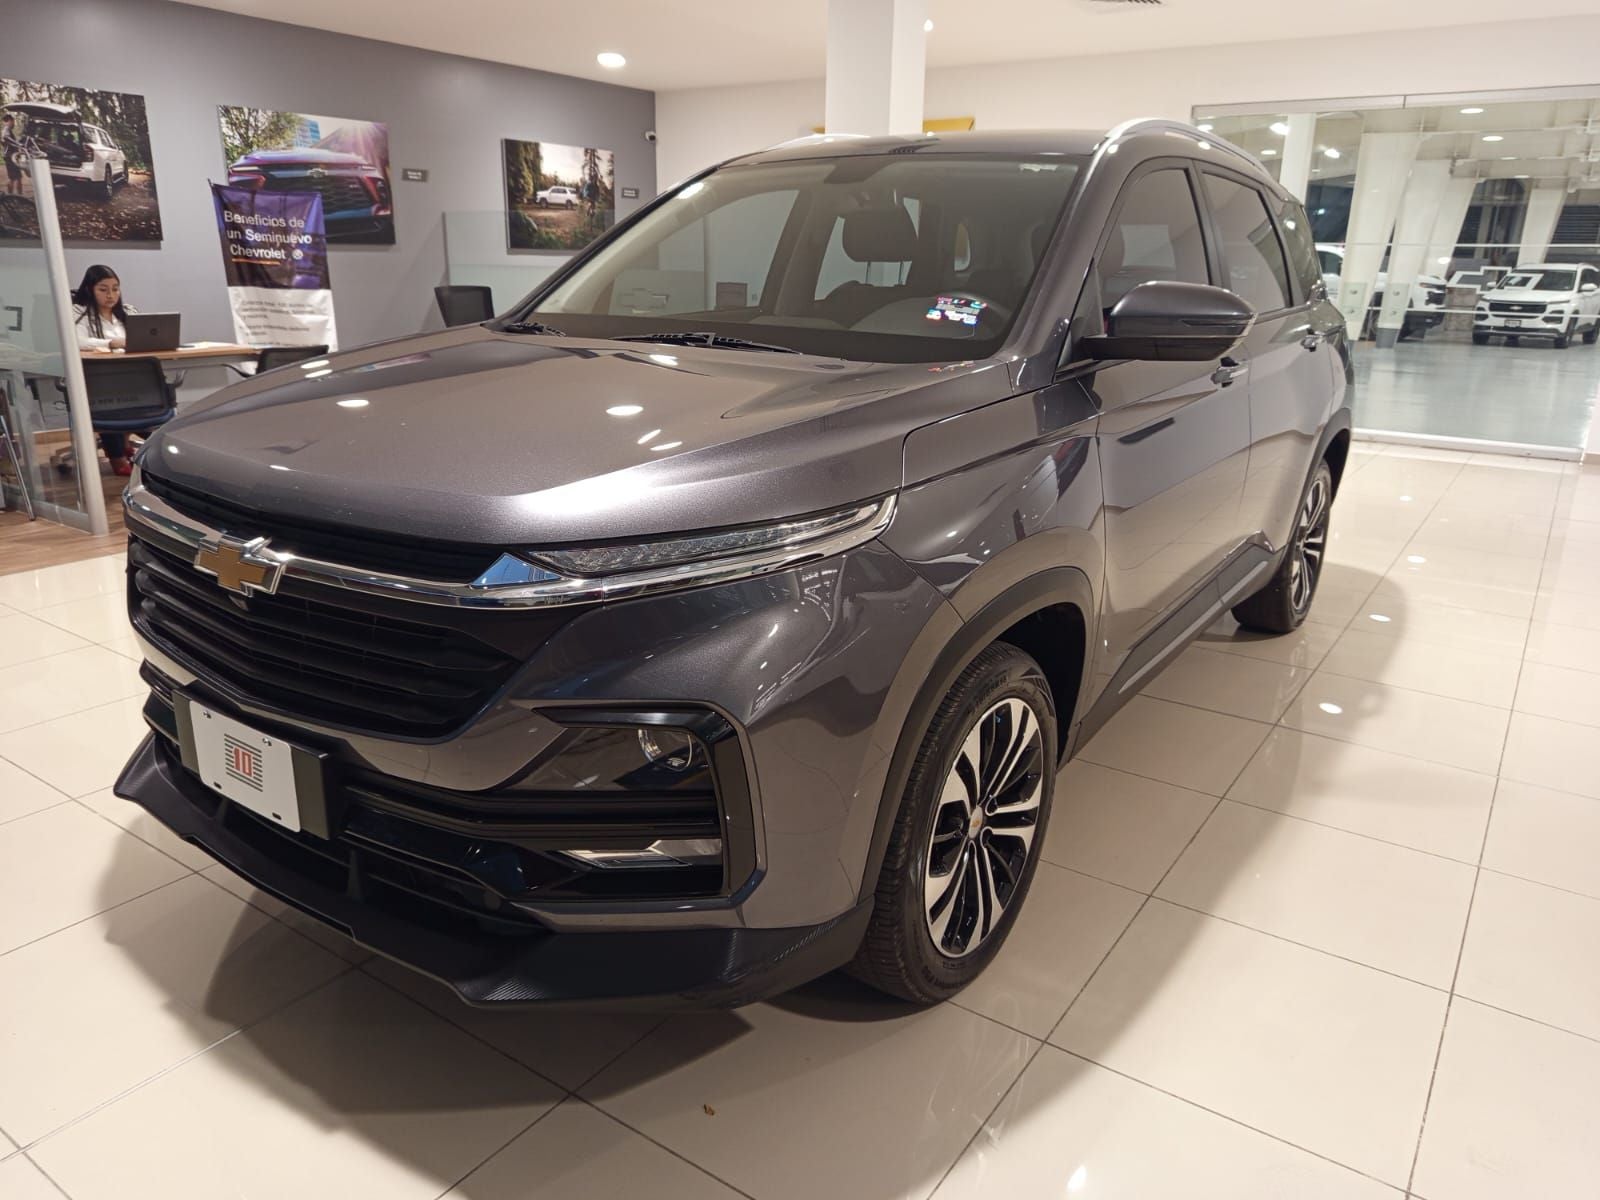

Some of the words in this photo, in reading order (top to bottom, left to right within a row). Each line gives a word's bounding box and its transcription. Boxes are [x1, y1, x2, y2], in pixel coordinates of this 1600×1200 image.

[224, 210, 286, 227] Beneficios
[289, 216, 305, 228] de
[227, 230, 241, 239] un
[245, 229, 312, 244] Seminuevo
[230, 244, 286, 259] Chevrolet
